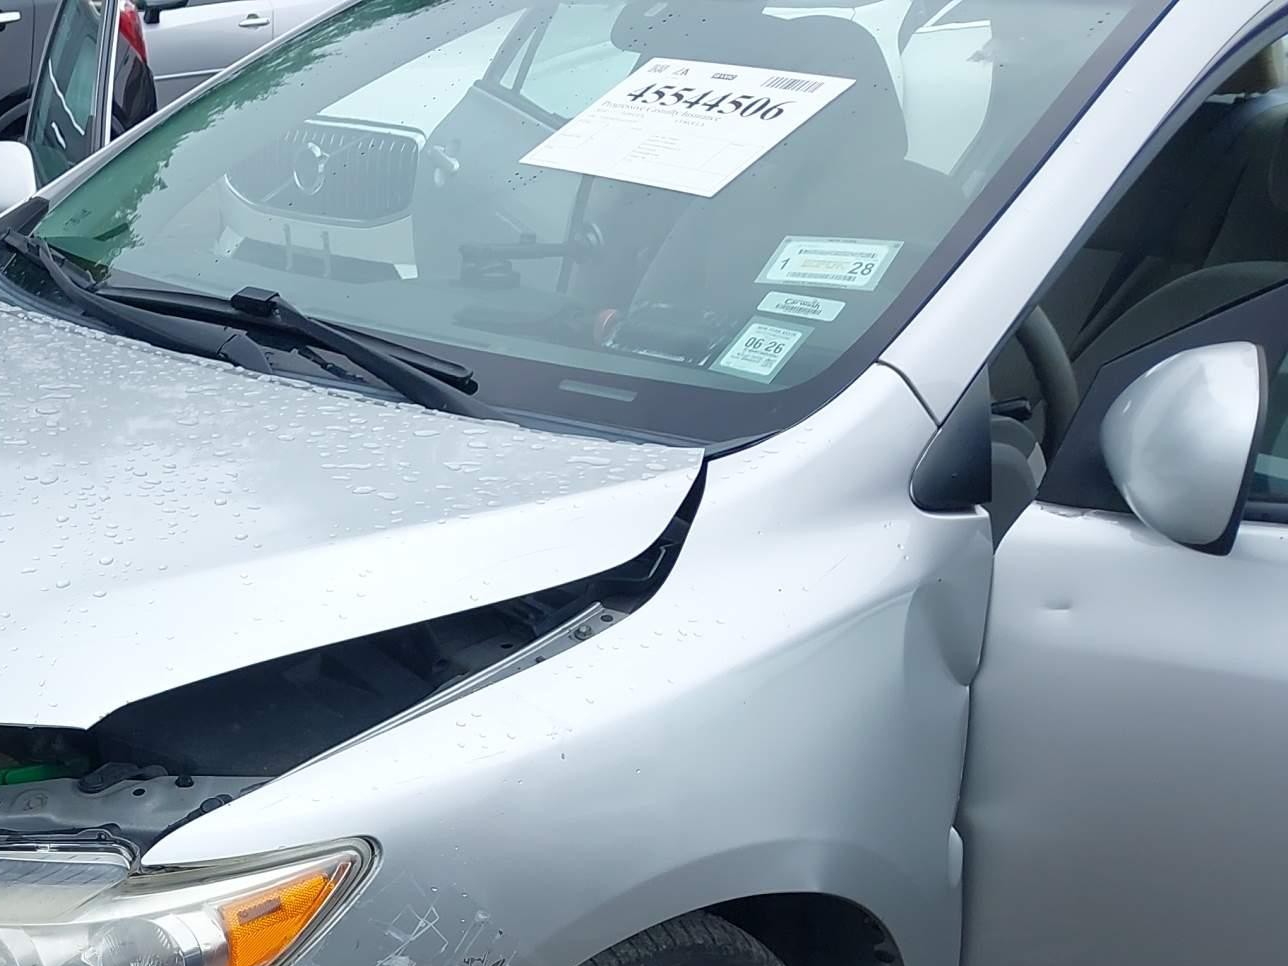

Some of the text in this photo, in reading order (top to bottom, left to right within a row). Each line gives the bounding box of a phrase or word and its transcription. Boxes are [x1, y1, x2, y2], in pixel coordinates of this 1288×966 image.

[626, 83, 797, 121] 45544506
[780, 257, 791, 270] 1
[848, 261, 875, 276] 28
[745, 336, 765, 349] 06
[764, 341, 785, 354] 26
